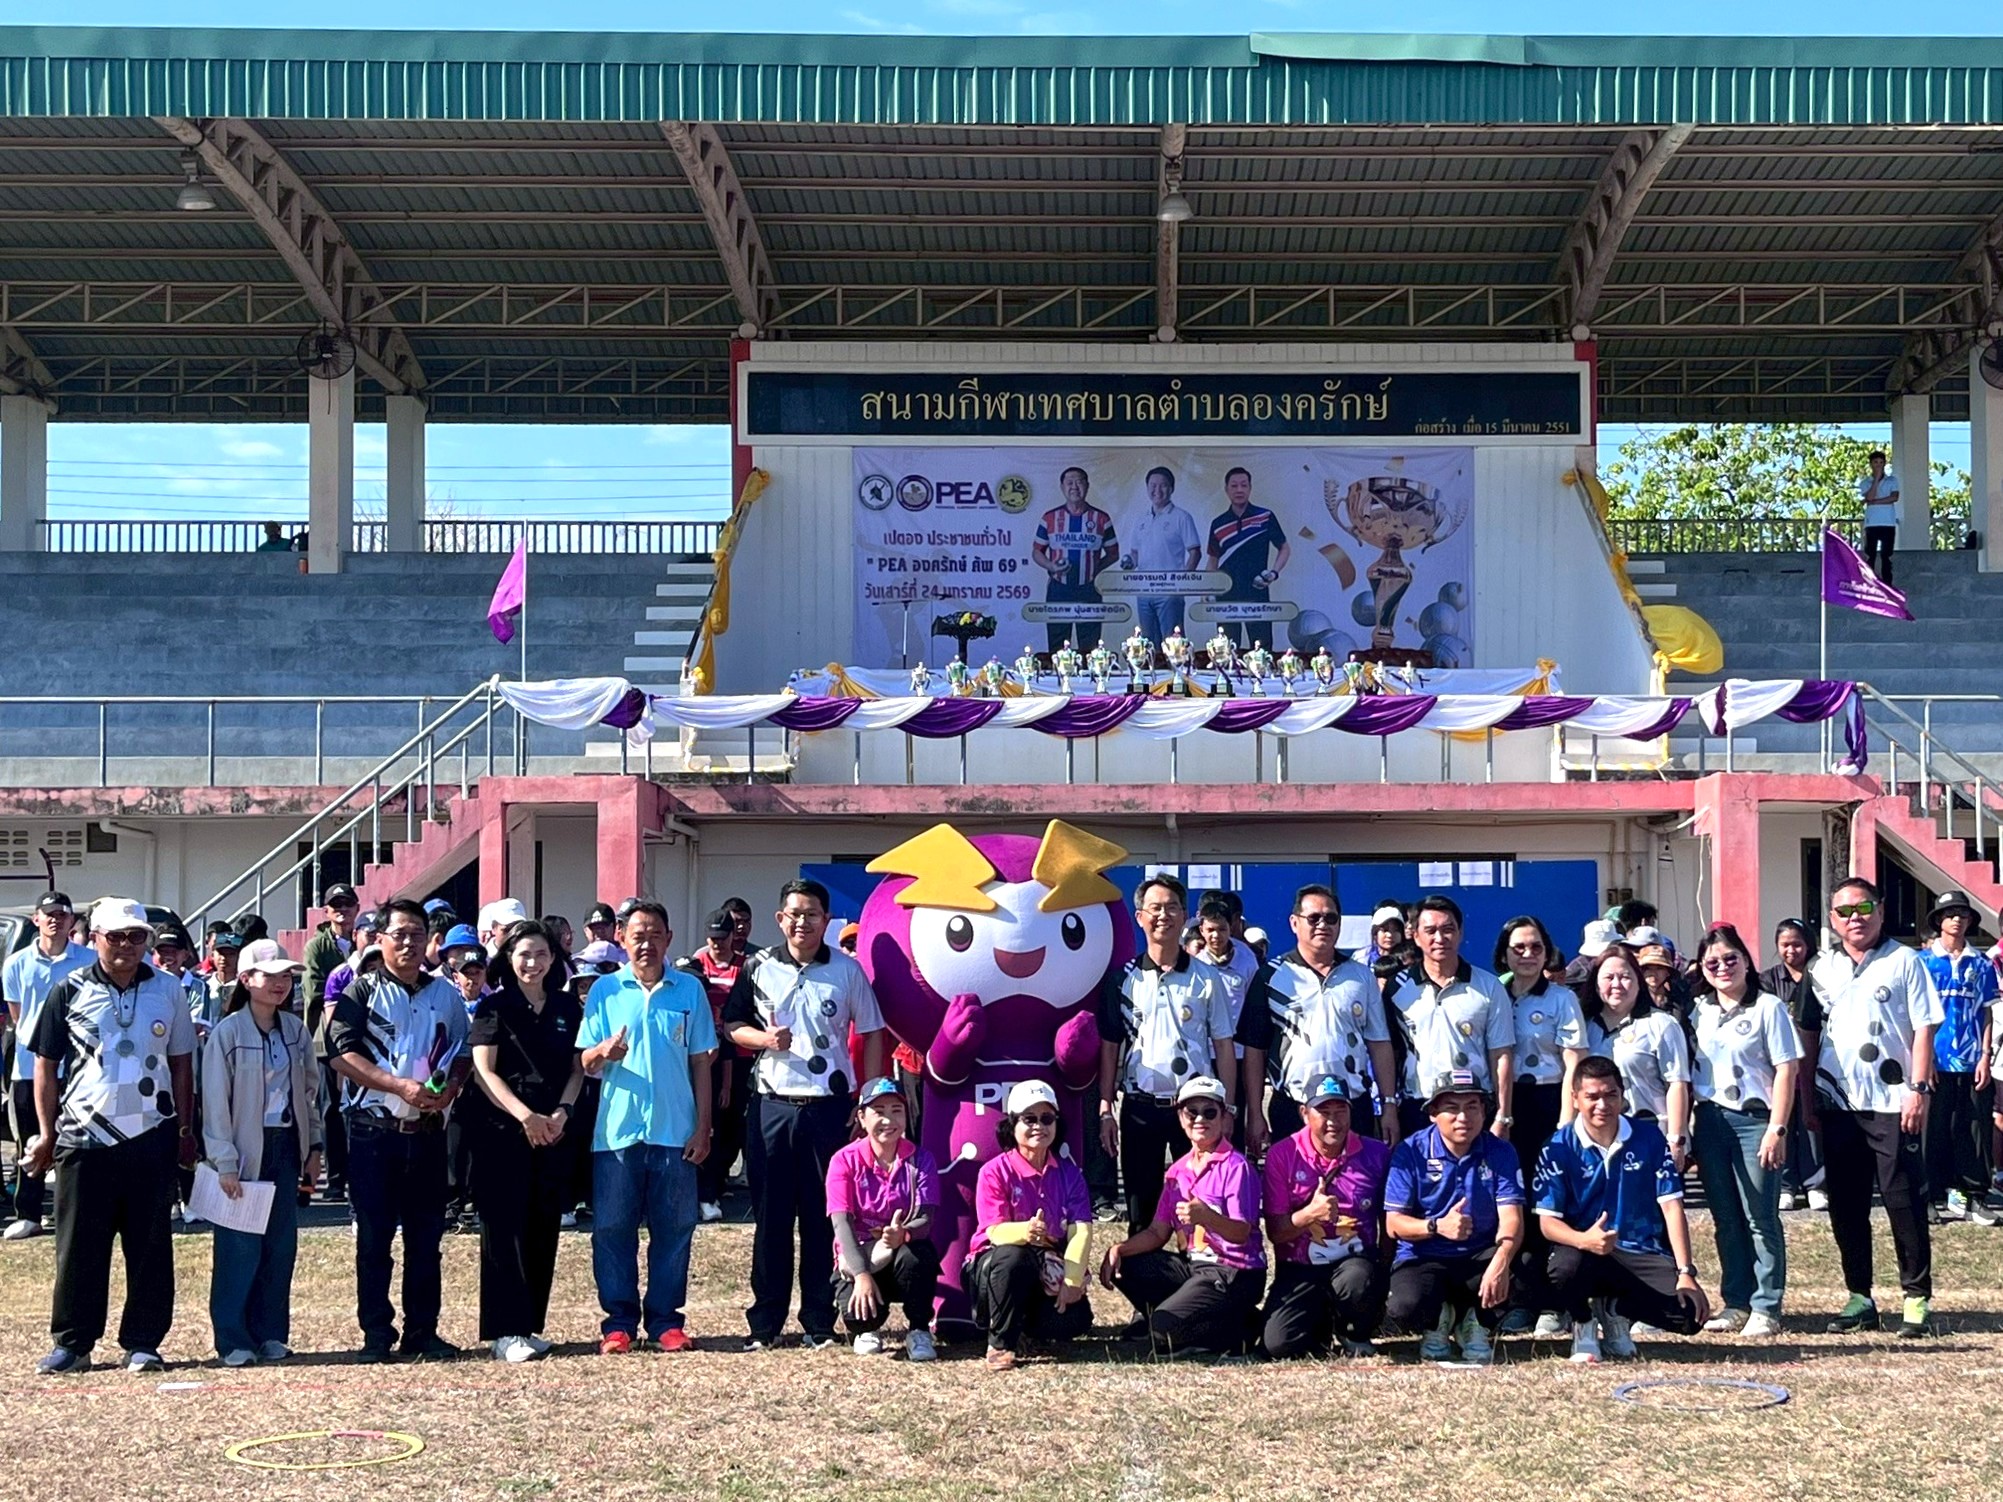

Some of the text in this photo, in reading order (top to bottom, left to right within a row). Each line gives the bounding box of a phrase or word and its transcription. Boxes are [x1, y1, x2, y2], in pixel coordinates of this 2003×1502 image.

[860, 377, 1392, 421] สนามกีฬาเทศบาลตำบลองครักษ์
[1415, 414, 1570, 433] ก่อสร้าง เมื่อ 15 มีนาคม 2551
[936, 482, 996, 504] PEA
[883, 526, 1012, 546] เปตอง ประชาชนทั่วไป
[1055, 533, 1097, 543] THAILAND
[878, 558, 908, 572] PEA
[912, 555, 967, 573] องครักษ์
[998, 559, 1017, 573] 69
[865, 578, 918, 599] วันเสาร์ที่
[997, 585, 1031, 599] 2569
